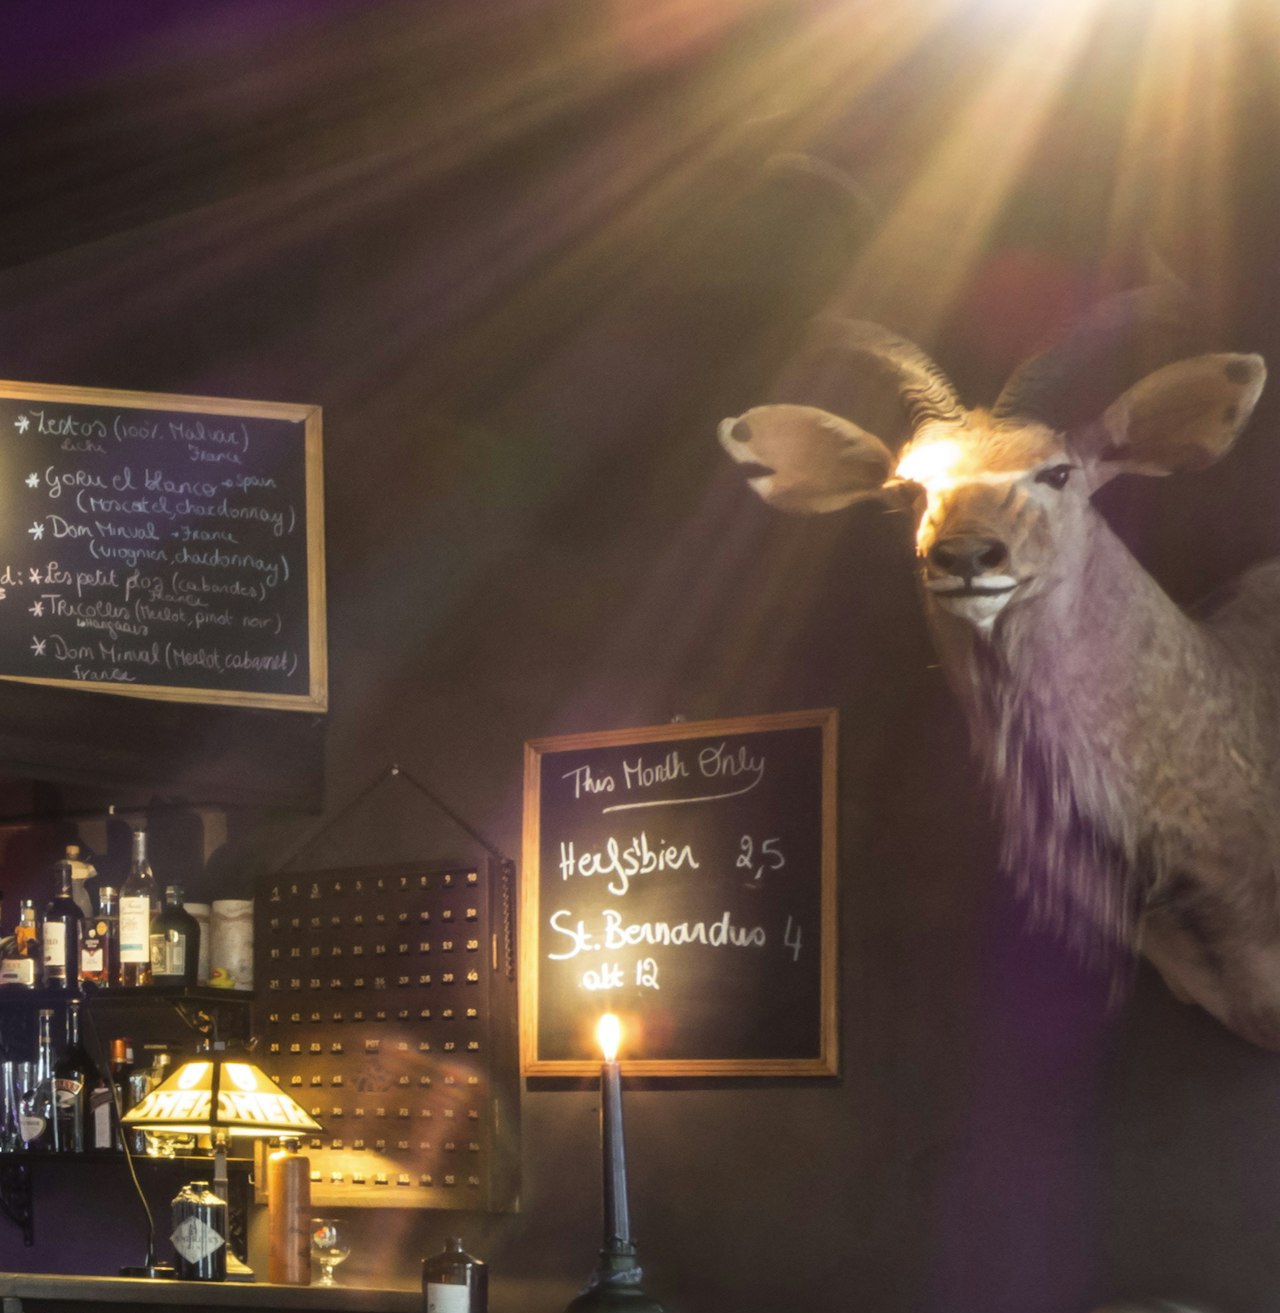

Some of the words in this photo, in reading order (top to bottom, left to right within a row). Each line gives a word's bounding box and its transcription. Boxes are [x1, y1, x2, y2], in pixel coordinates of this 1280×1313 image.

[46, 514, 93, 539] Dom
[49, 633, 96, 661] Dom
[561, 764, 616, 799] This
[622, 750, 689, 790] Month
[697, 742, 766, 788] Only
[735, 834, 787, 881] 2,5
[783, 914, 803, 963] 4
[635, 956, 661, 991] 12
